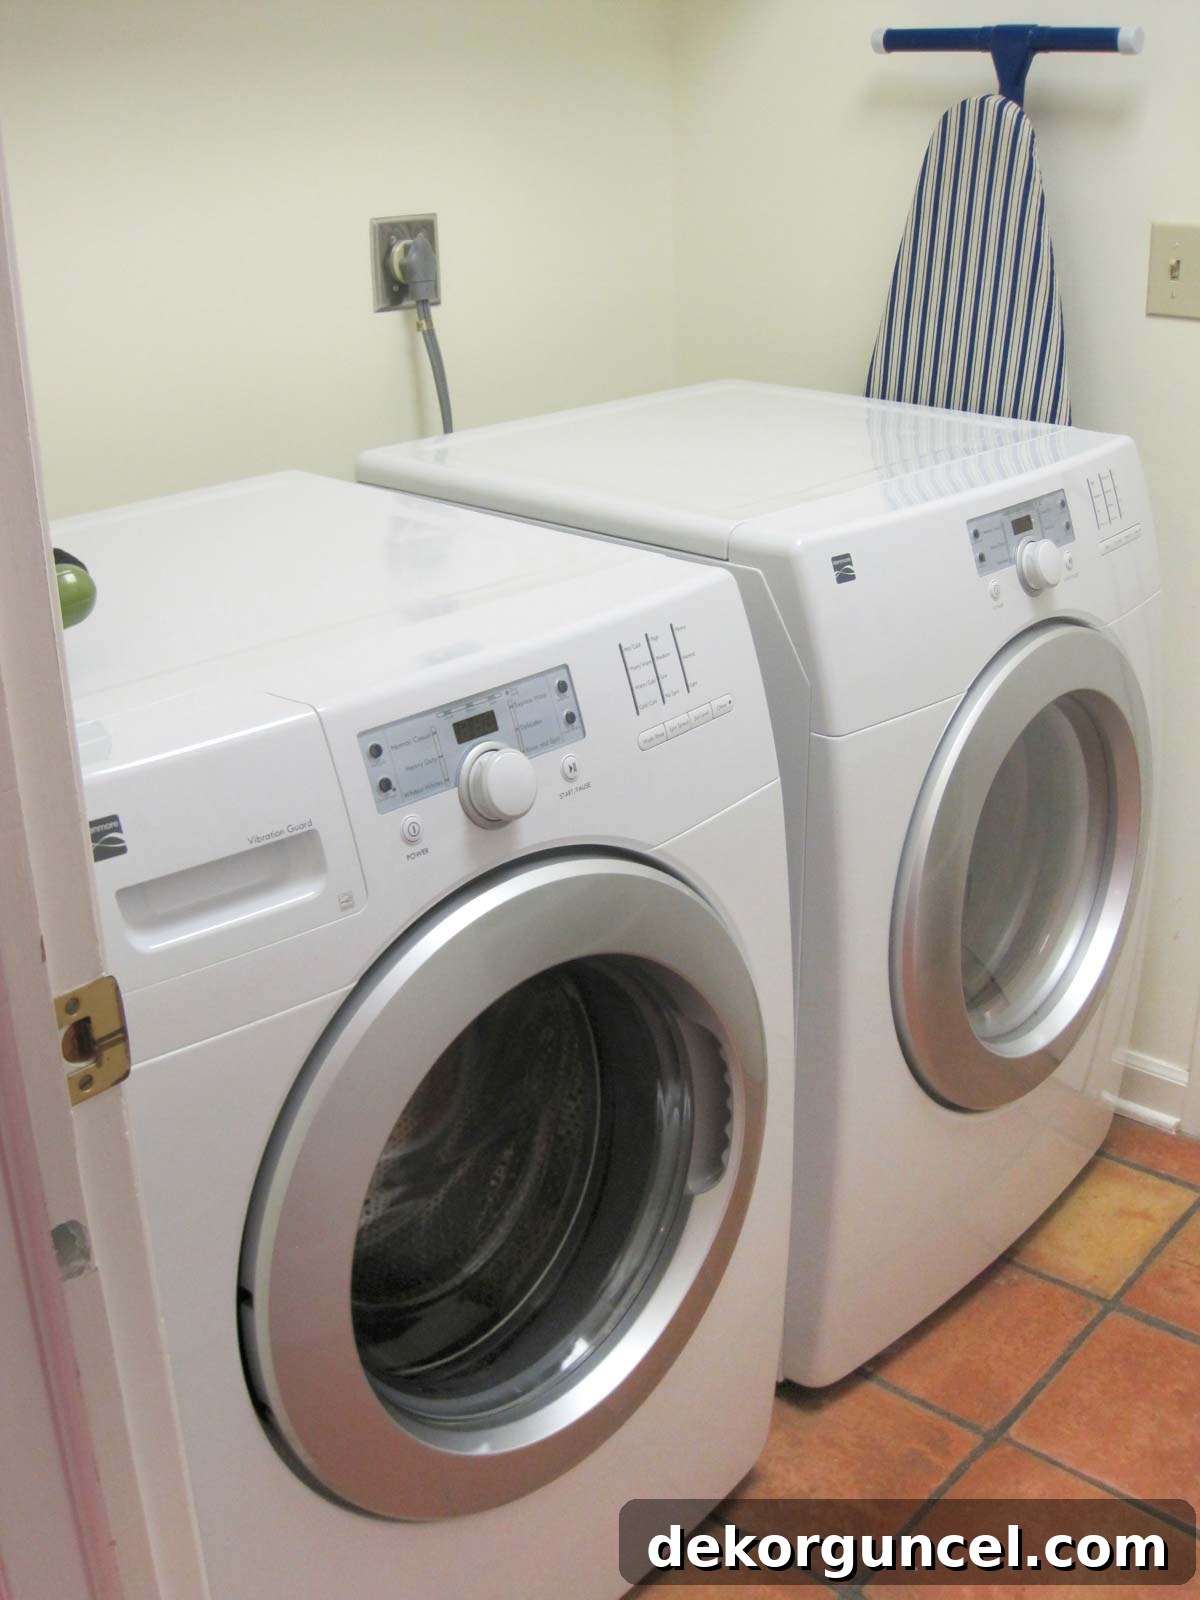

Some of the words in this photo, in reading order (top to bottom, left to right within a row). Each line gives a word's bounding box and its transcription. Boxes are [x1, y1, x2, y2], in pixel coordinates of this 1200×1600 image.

[247, 829, 286, 845] Vibration
[286, 817, 313, 833] Guard
[406, 847, 430, 861] POWER
